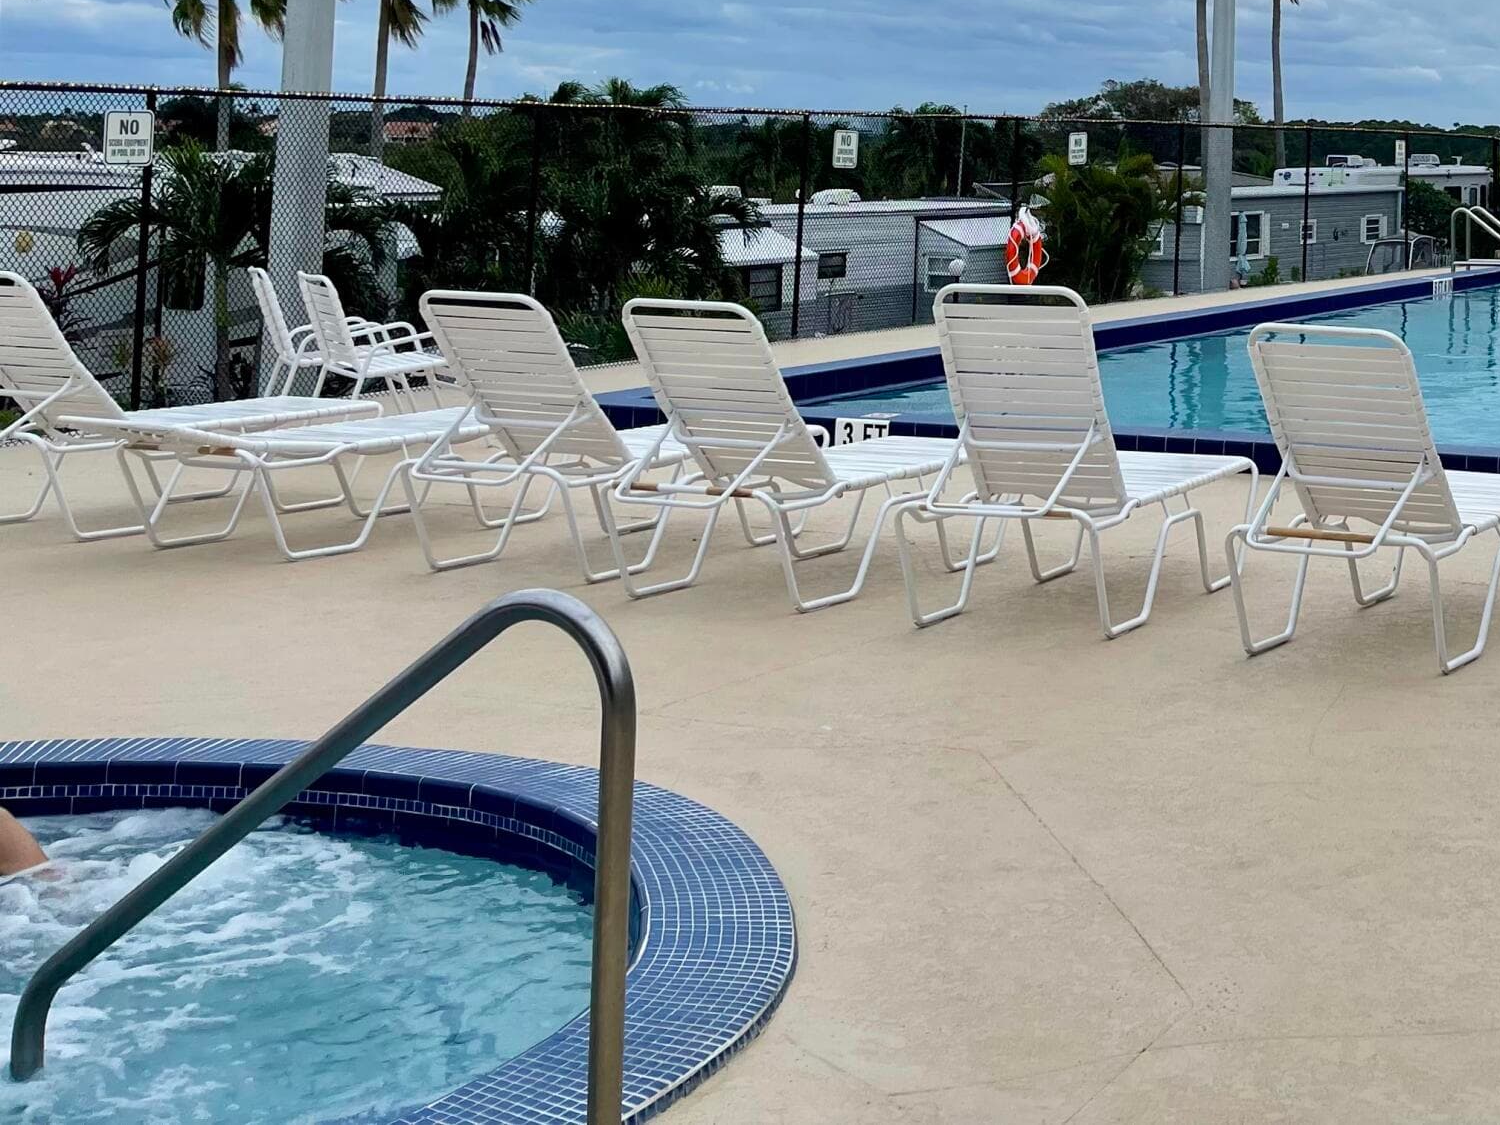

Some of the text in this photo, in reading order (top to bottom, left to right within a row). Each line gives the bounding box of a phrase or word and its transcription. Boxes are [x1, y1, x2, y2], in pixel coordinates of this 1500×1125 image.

[120, 119, 139, 135] NO
[840, 135, 852, 146] NO
[843, 422, 888, 445] 3 FT
